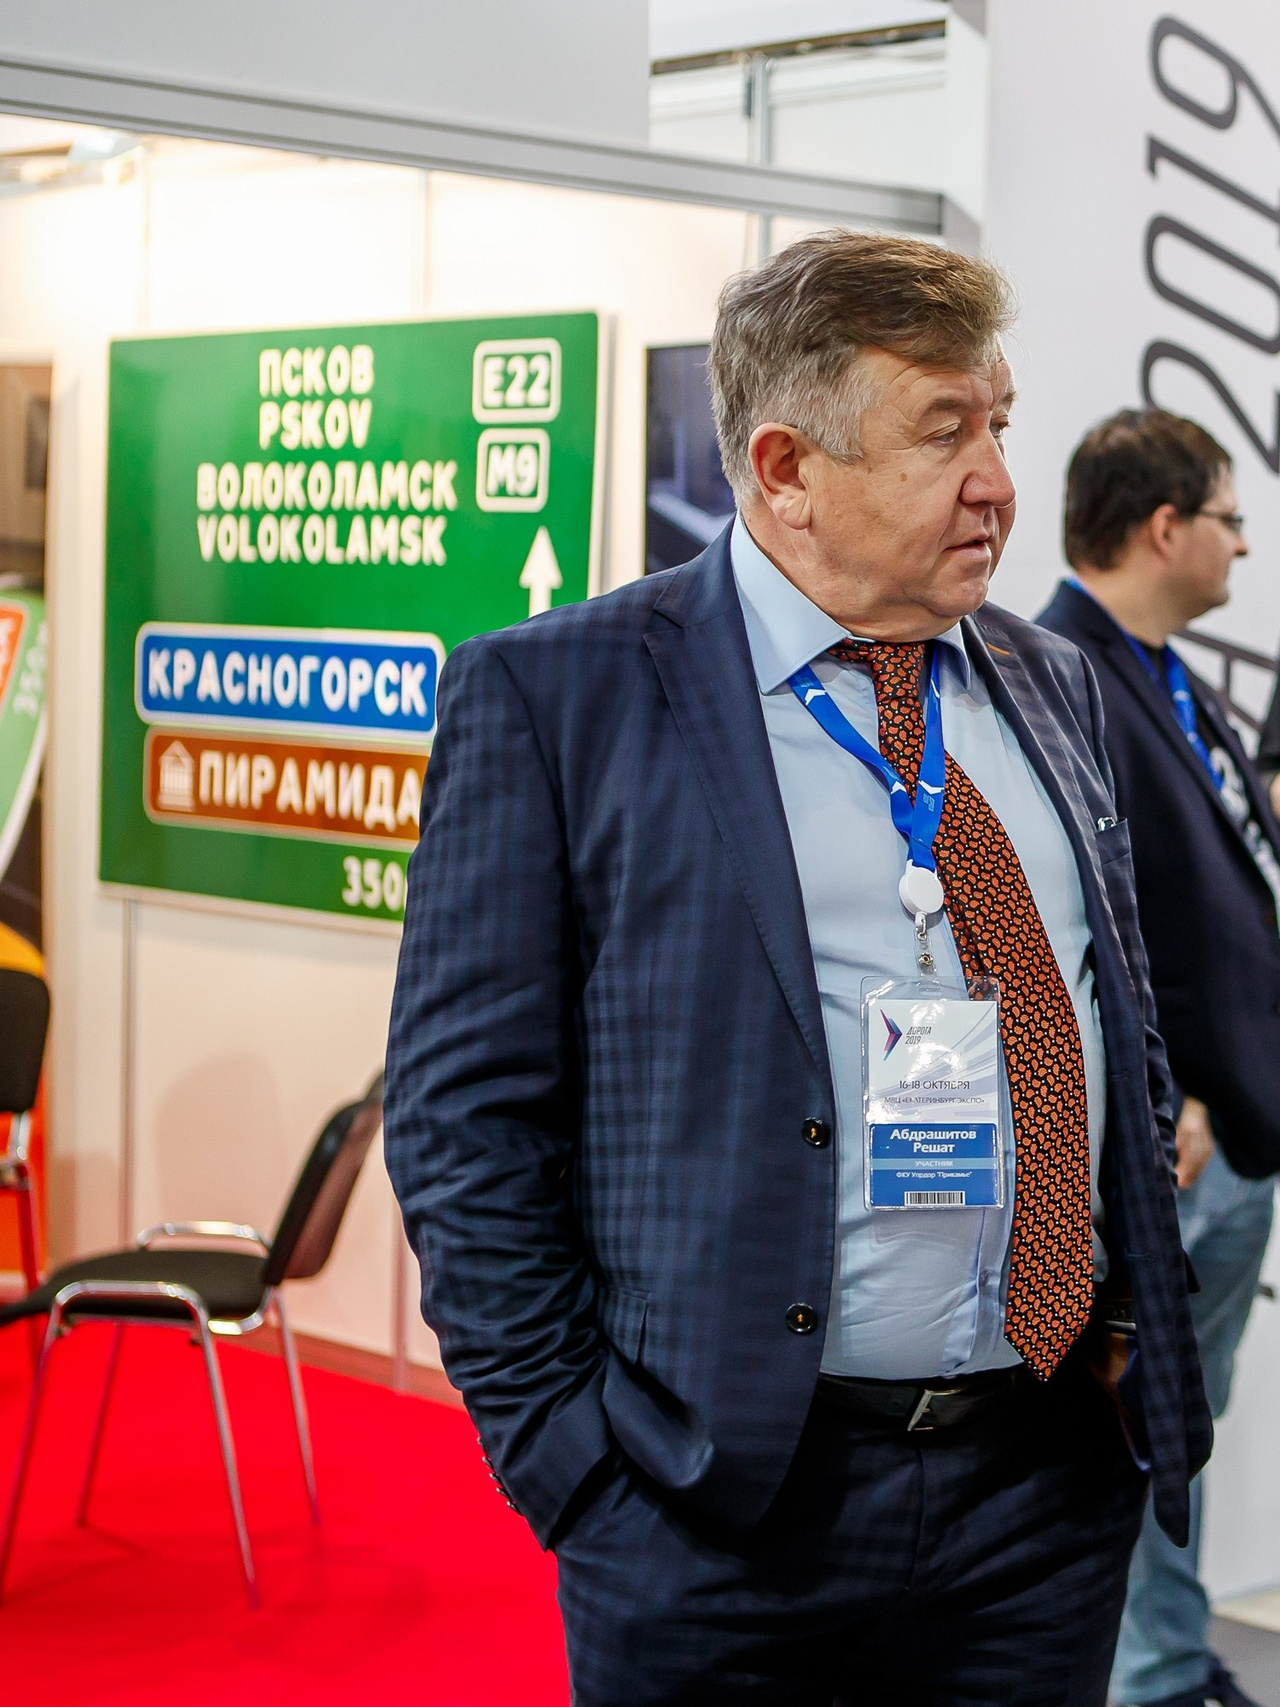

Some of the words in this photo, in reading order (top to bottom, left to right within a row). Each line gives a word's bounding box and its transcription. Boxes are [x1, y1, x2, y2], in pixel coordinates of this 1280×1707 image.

[259, 345, 374, 398] ПСКОВ
[483, 354, 551, 406] E22
[258, 398, 373, 450] PSKOV
[196, 460, 458, 511] ВОЛОКОЛАМСК
[486, 444, 537, 495] М9
[196, 515, 448, 567] VOLOKOLAMSK
[147, 648, 428, 717] КРАСНОГОРСК
[199, 750, 420, 832] ПИРАМИДА
[342, 855, 404, 912] 350
[905, 1035, 922, 1045] 2019
[899, 1080, 921, 1090] 16-18
[922, 1080, 971, 1090] ОКТЯБРЯ
[890, 1128, 977, 1142] Абдрашитов
[913, 1142, 956, 1153] Решат
[915, 1160, 954, 1168] УЧАСТНИК
